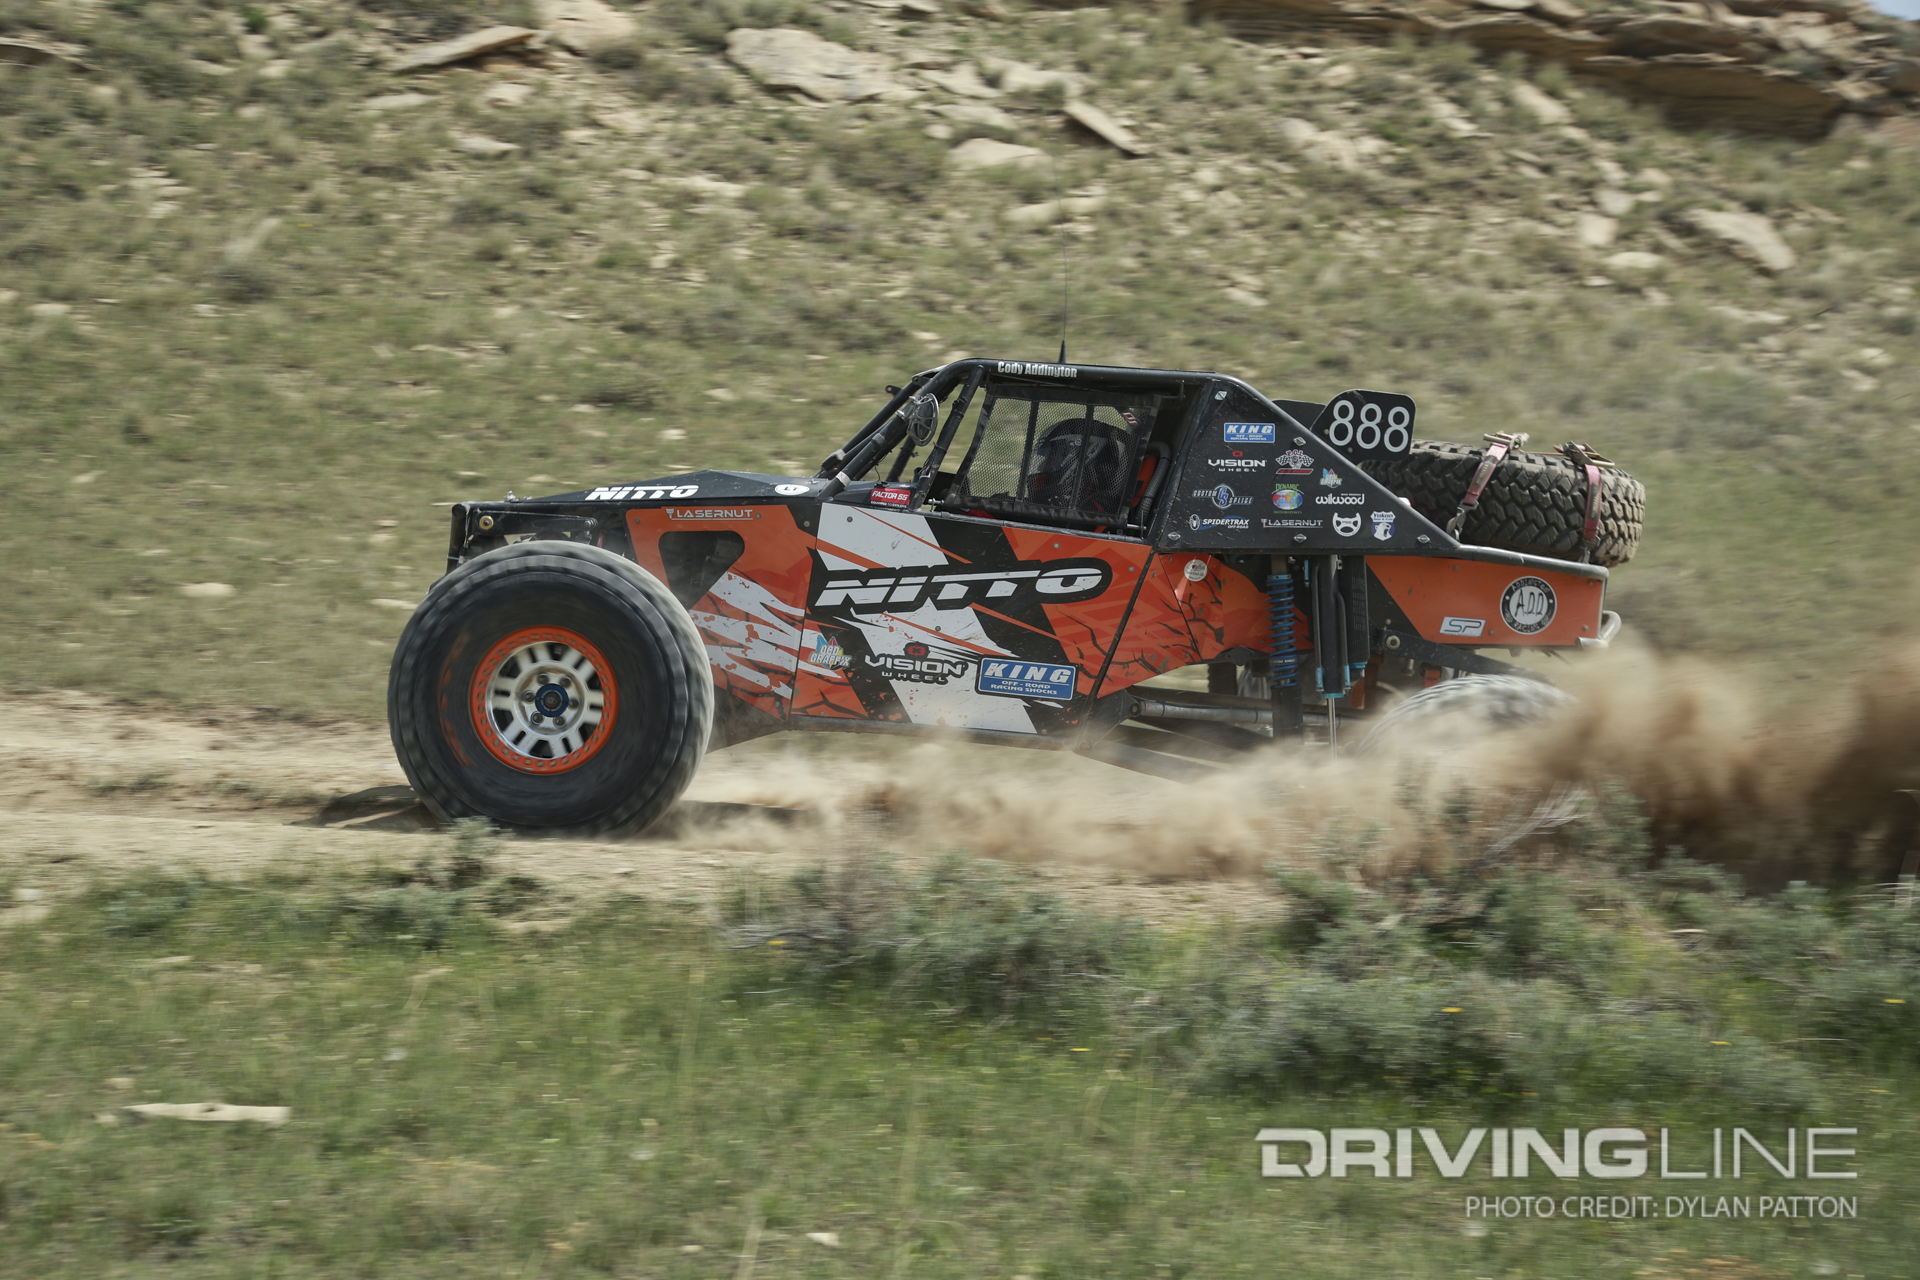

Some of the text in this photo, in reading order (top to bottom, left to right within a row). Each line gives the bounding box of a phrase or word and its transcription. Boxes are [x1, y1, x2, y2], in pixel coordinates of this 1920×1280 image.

[997, 361, 1078, 378] Cody Addington
[1226, 424, 1273, 434] KING
[1329, 399, 1410, 453] 888
[1207, 458, 1266, 468] VISION
[584, 485, 699, 500] NITTO
[1275, 483, 1300, 492] DYNAMIC
[872, 490, 897, 500] FACTOR
[1315, 492, 1365, 505] wilwood
[676, 508, 754, 518] LASERNUT
[1202, 518, 1250, 526] SPIDERTRAX
[1268, 518, 1323, 527] LASERNUT
[814, 567, 1103, 607] NITTO
[864, 654, 963, 676] VISION
[881, 671, 946, 682] WHEEL
[984, 662, 1072, 684] KING
[990, 684, 1058, 695] RACING SHOCKS
